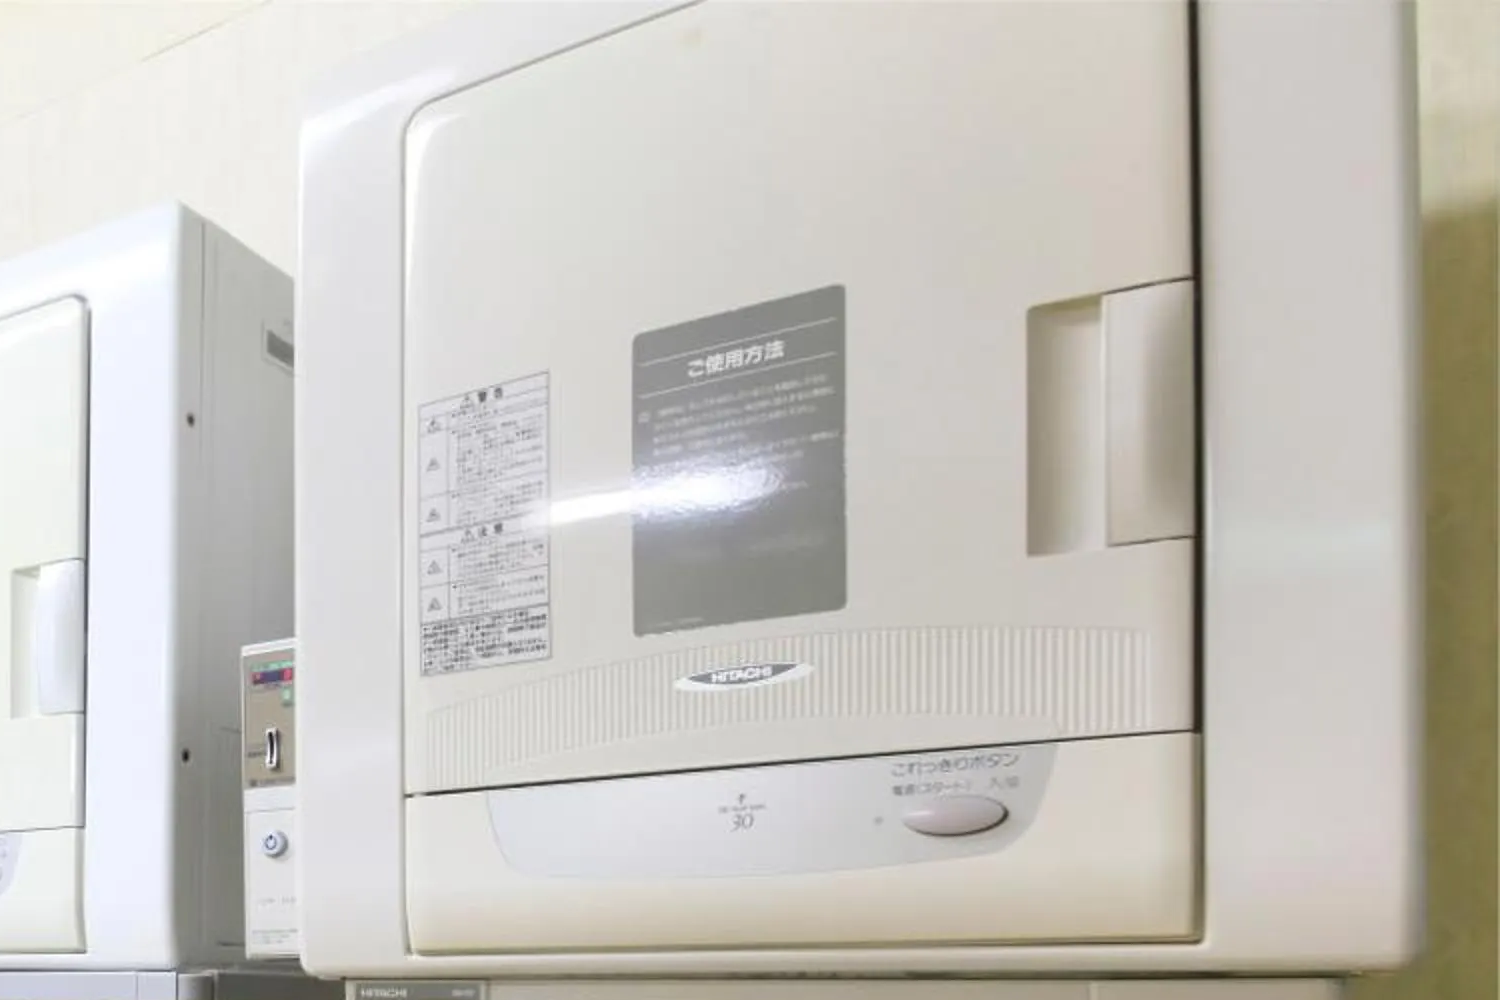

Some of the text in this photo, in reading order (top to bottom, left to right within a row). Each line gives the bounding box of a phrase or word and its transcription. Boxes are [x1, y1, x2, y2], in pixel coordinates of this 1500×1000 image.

[687, 340, 785, 378] ご使用方法
[711, 666, 773, 683] HITACHI
[360, 987, 408, 999] HITACHI
